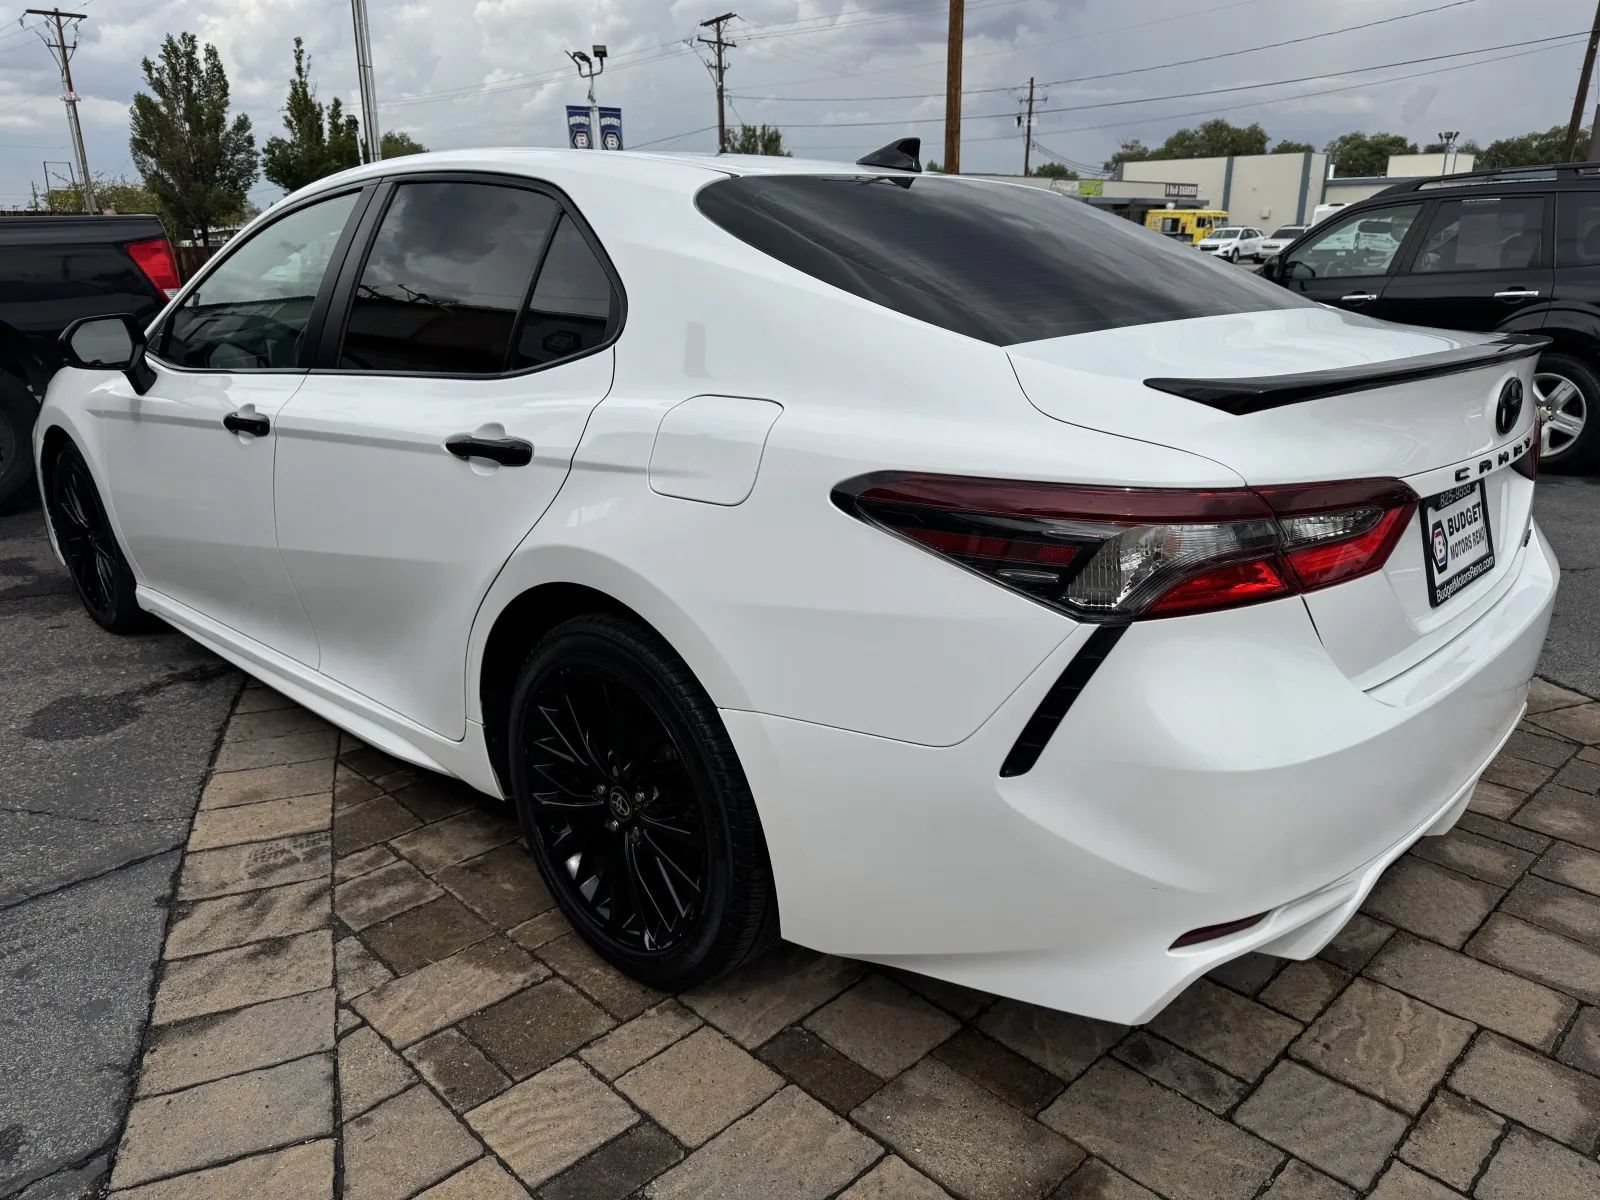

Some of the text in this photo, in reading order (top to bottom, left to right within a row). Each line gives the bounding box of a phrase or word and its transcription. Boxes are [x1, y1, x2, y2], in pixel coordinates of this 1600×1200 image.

[1455, 437, 1531, 482] CAMRY
[1447, 501, 1482, 536] BUDGET
[1450, 533, 1472, 560] MOTORS
[1436, 555, 1495, 602] BudgetMotorsReno.com
